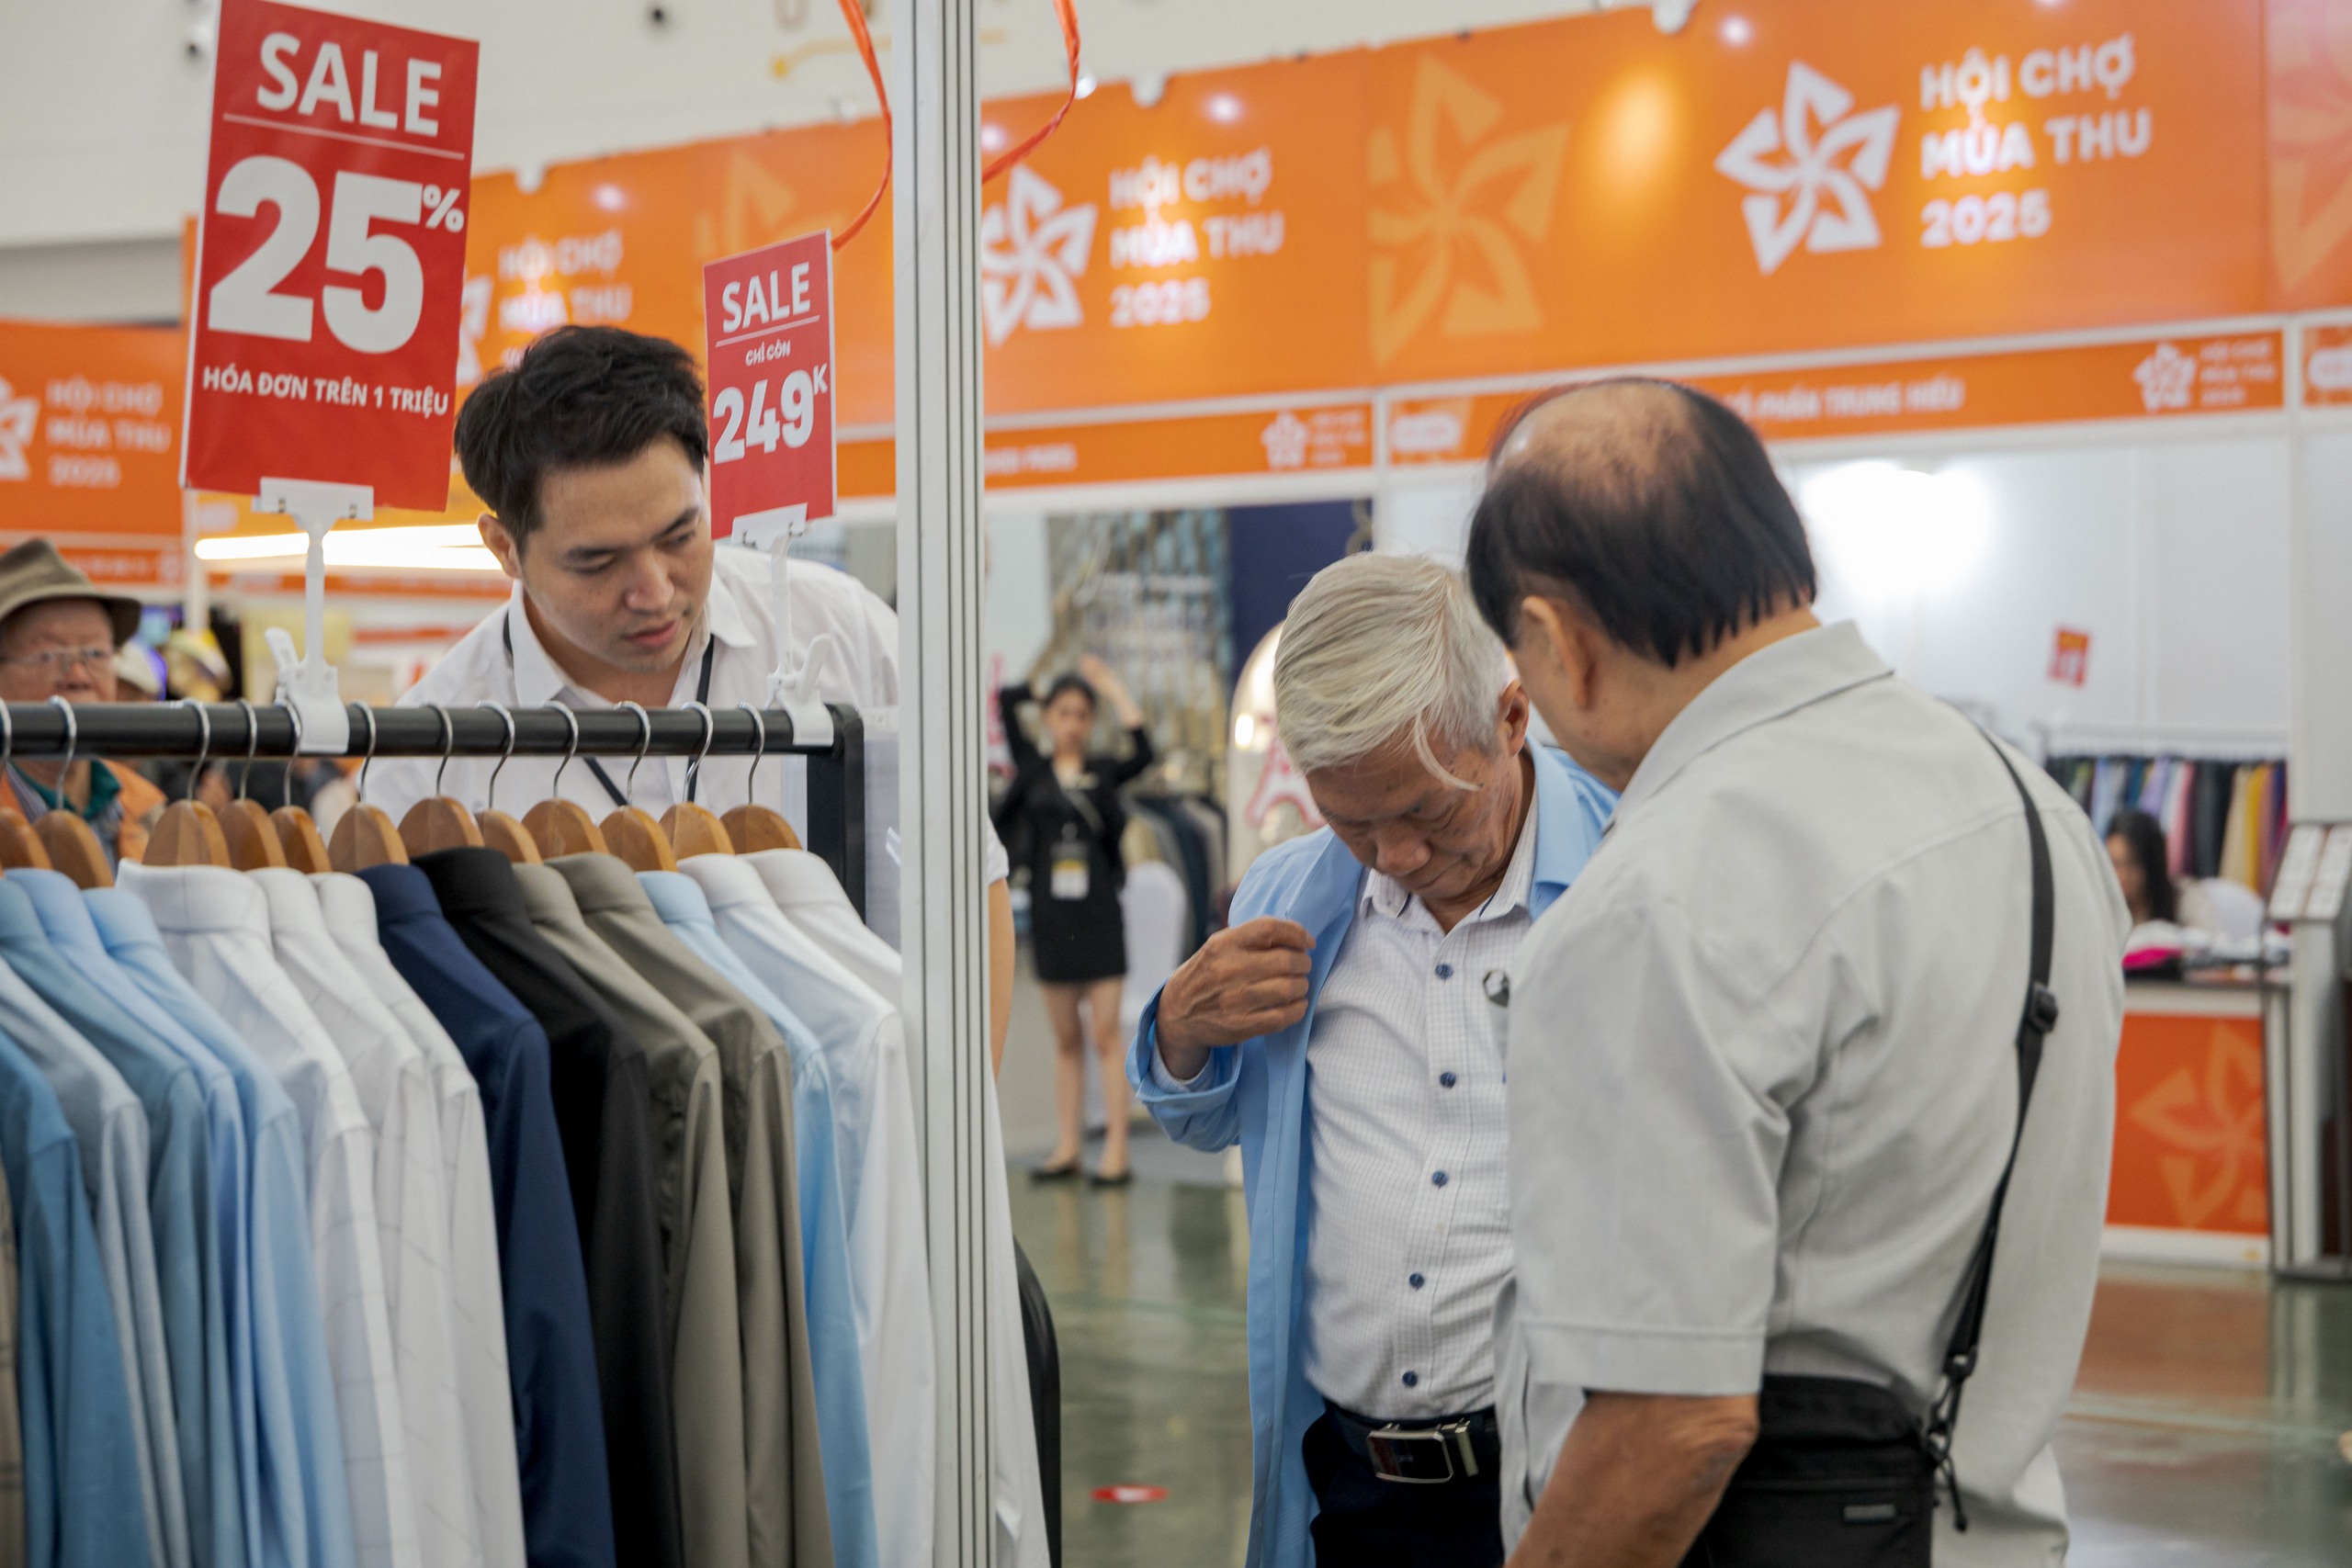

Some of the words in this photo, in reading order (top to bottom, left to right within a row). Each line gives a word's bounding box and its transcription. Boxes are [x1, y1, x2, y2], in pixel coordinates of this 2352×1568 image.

[256, 32, 443, 137] SALE
[1920, 46, 2011, 114] HỘI
[2018, 33, 2136, 100] CHỢ
[1108, 154, 1181, 212] HỘI
[1182, 146, 1272, 206] CHỢ
[1920, 114, 2036, 180] MÙA
[2044, 107, 2153, 164] THU
[208, 154, 465, 355] 25%
[1203, 209, 1285, 259] THU
[1919, 188, 2052, 249] 2025
[721, 261, 811, 334] SALE
[1109, 276, 1212, 329] 2025
[203, 363, 254, 394] HÓA
[258, 371, 309, 401] ĐƠN
[313, 376, 368, 408] TRÊN
[373, 385, 384, 410] 1
[389, 385, 449, 421] TRIỆU
[713, 363, 829, 465] 249K
